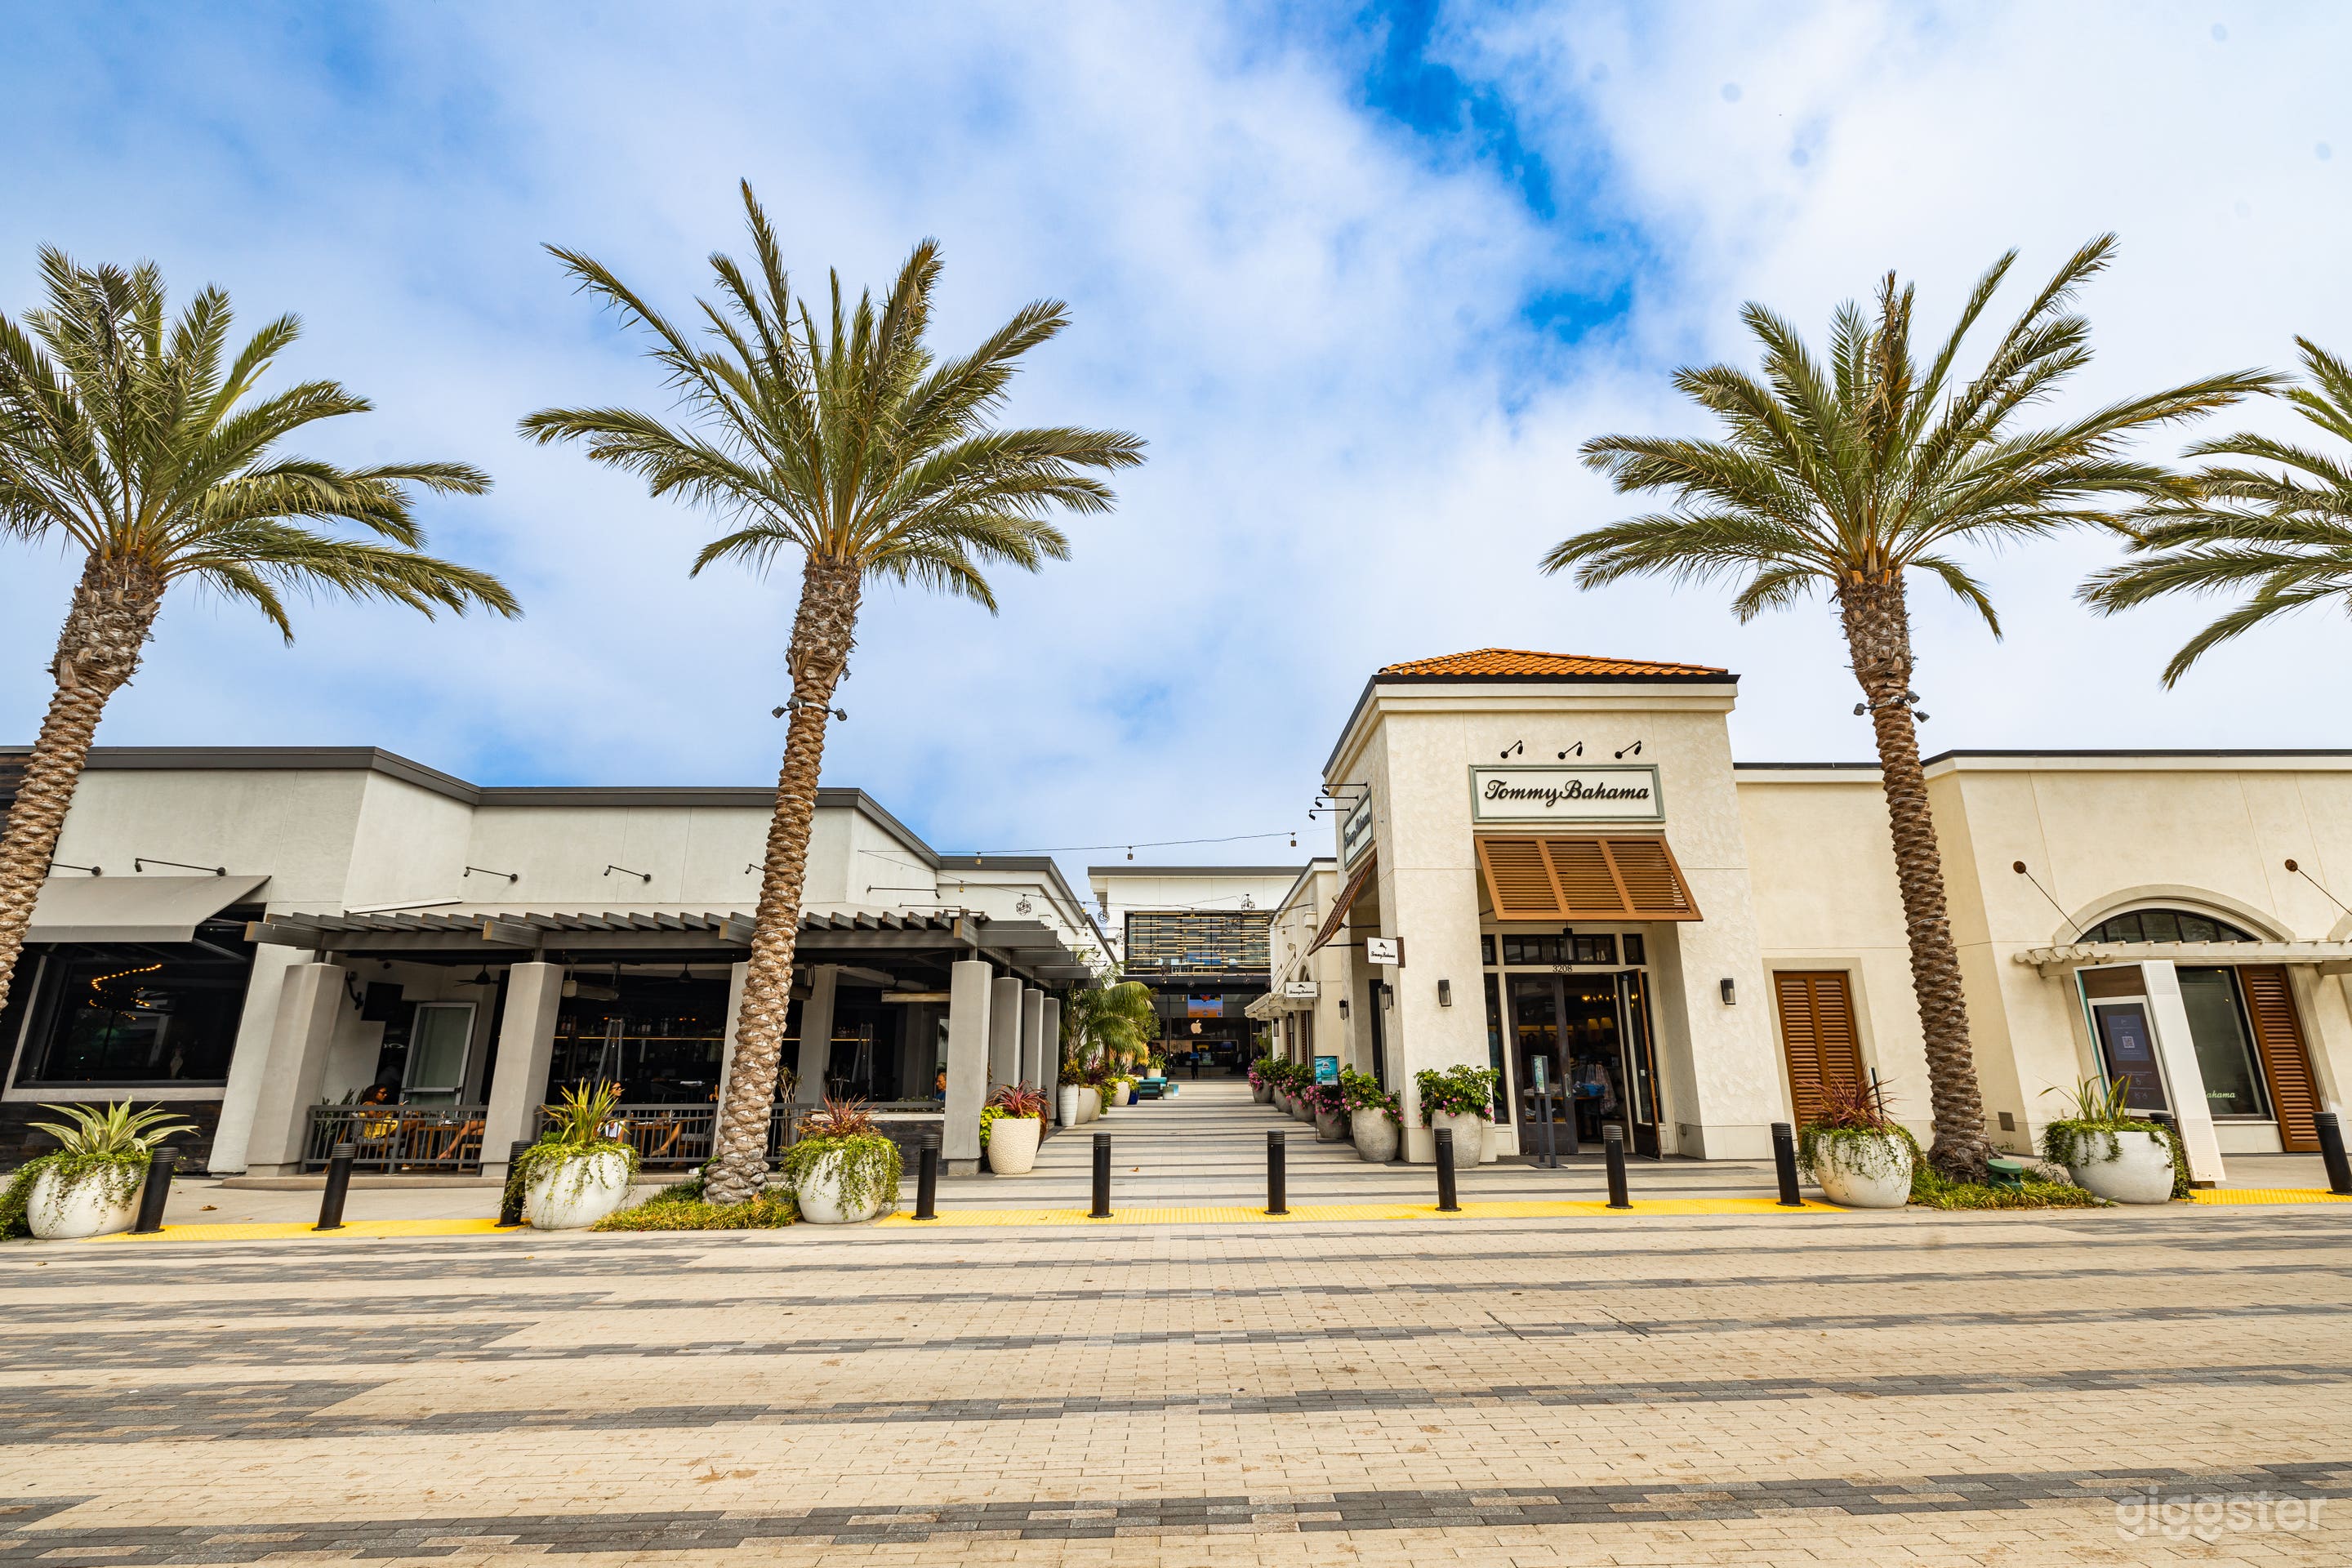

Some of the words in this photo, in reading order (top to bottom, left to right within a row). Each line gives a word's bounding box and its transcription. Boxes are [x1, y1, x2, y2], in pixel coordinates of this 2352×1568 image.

[1485, 779, 1560, 808] Tommy
[1560, 779, 1649, 800] Bahama
[1552, 964, 1573, 973] 3208
[2206, 1089, 2236, 1098] ahama
